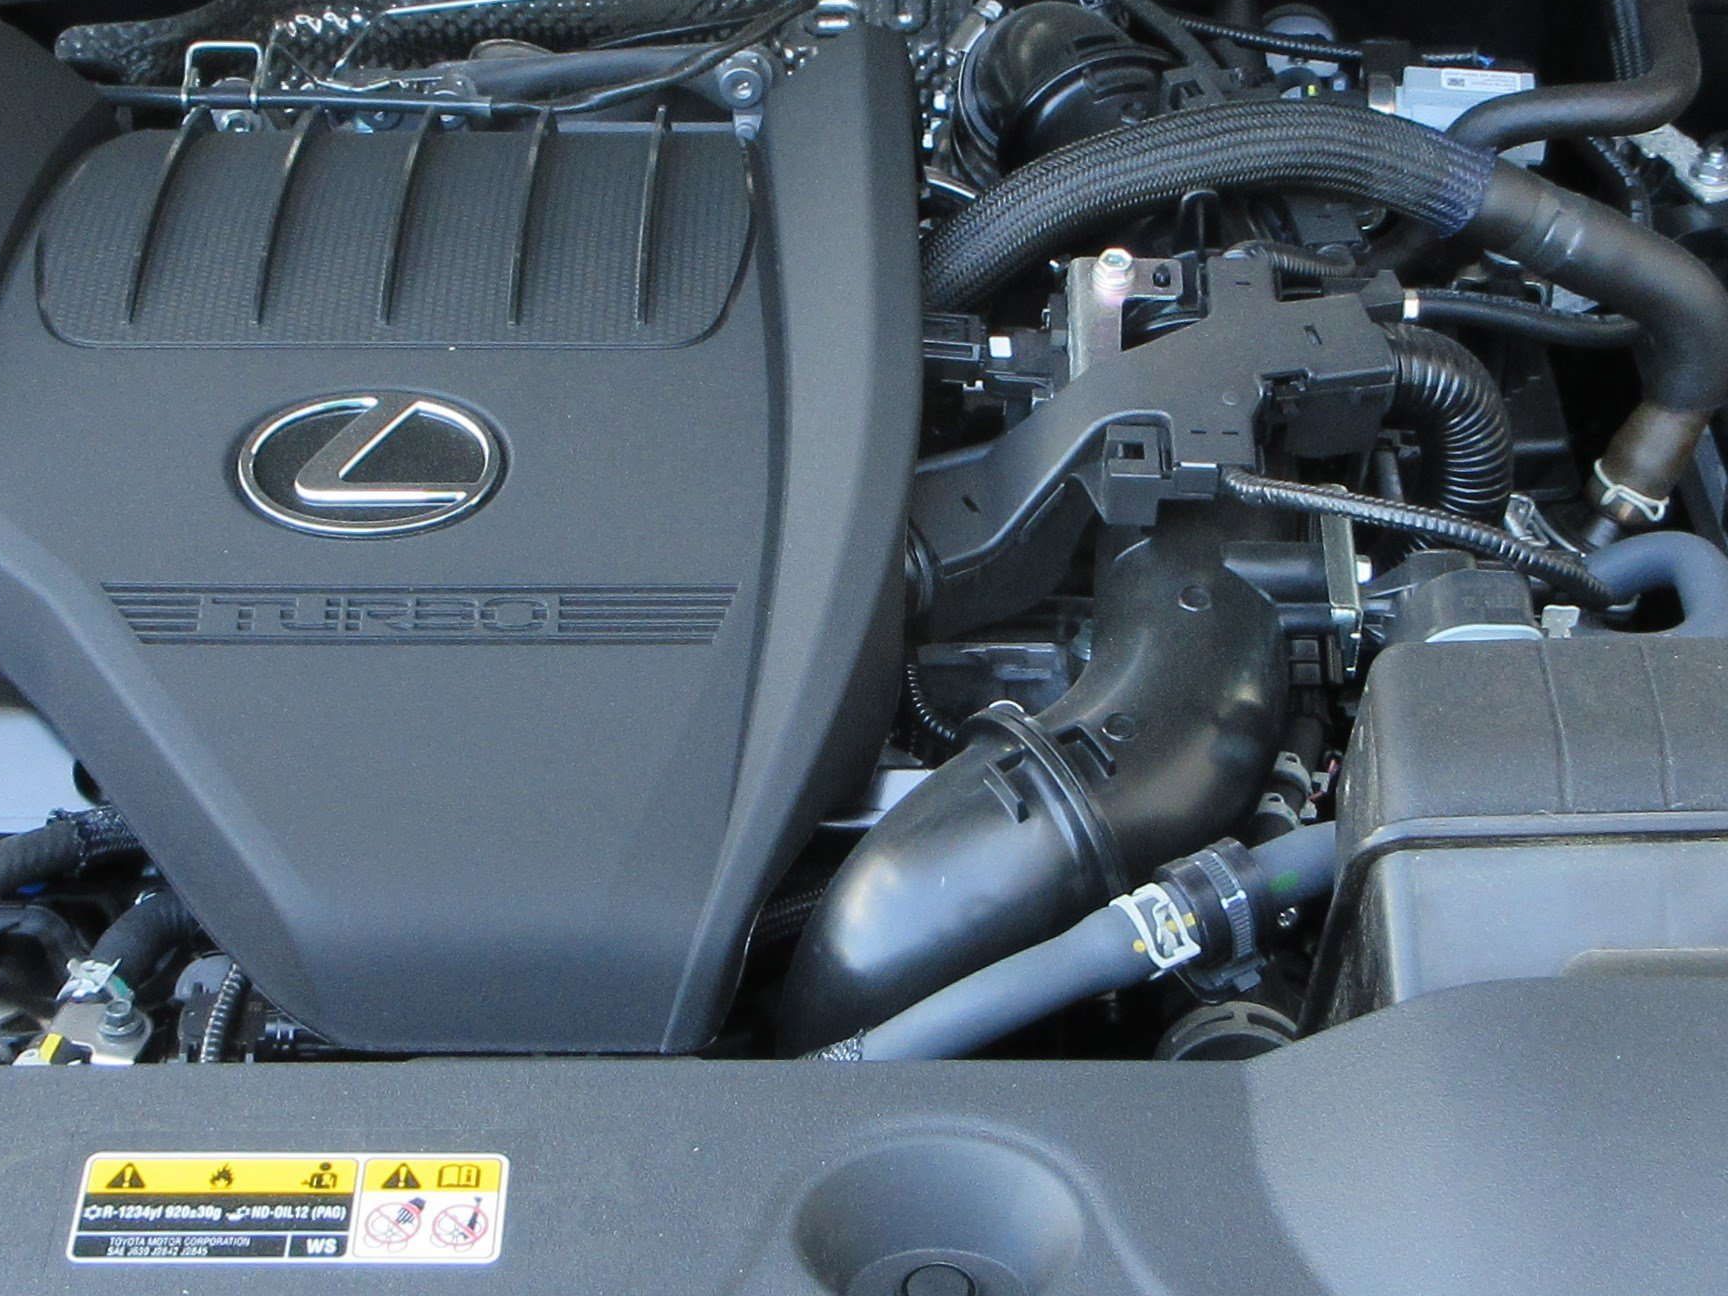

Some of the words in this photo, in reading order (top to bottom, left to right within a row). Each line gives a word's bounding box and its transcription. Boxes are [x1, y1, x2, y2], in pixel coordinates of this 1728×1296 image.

[209, 595, 553, 632] TURBO
[109, 1236, 146, 1247] TOYOTA
[147, 1236, 182, 1247] MOTOR
[183, 1236, 251, 1247] CORPORATION
[306, 1237, 338, 1255] WS
